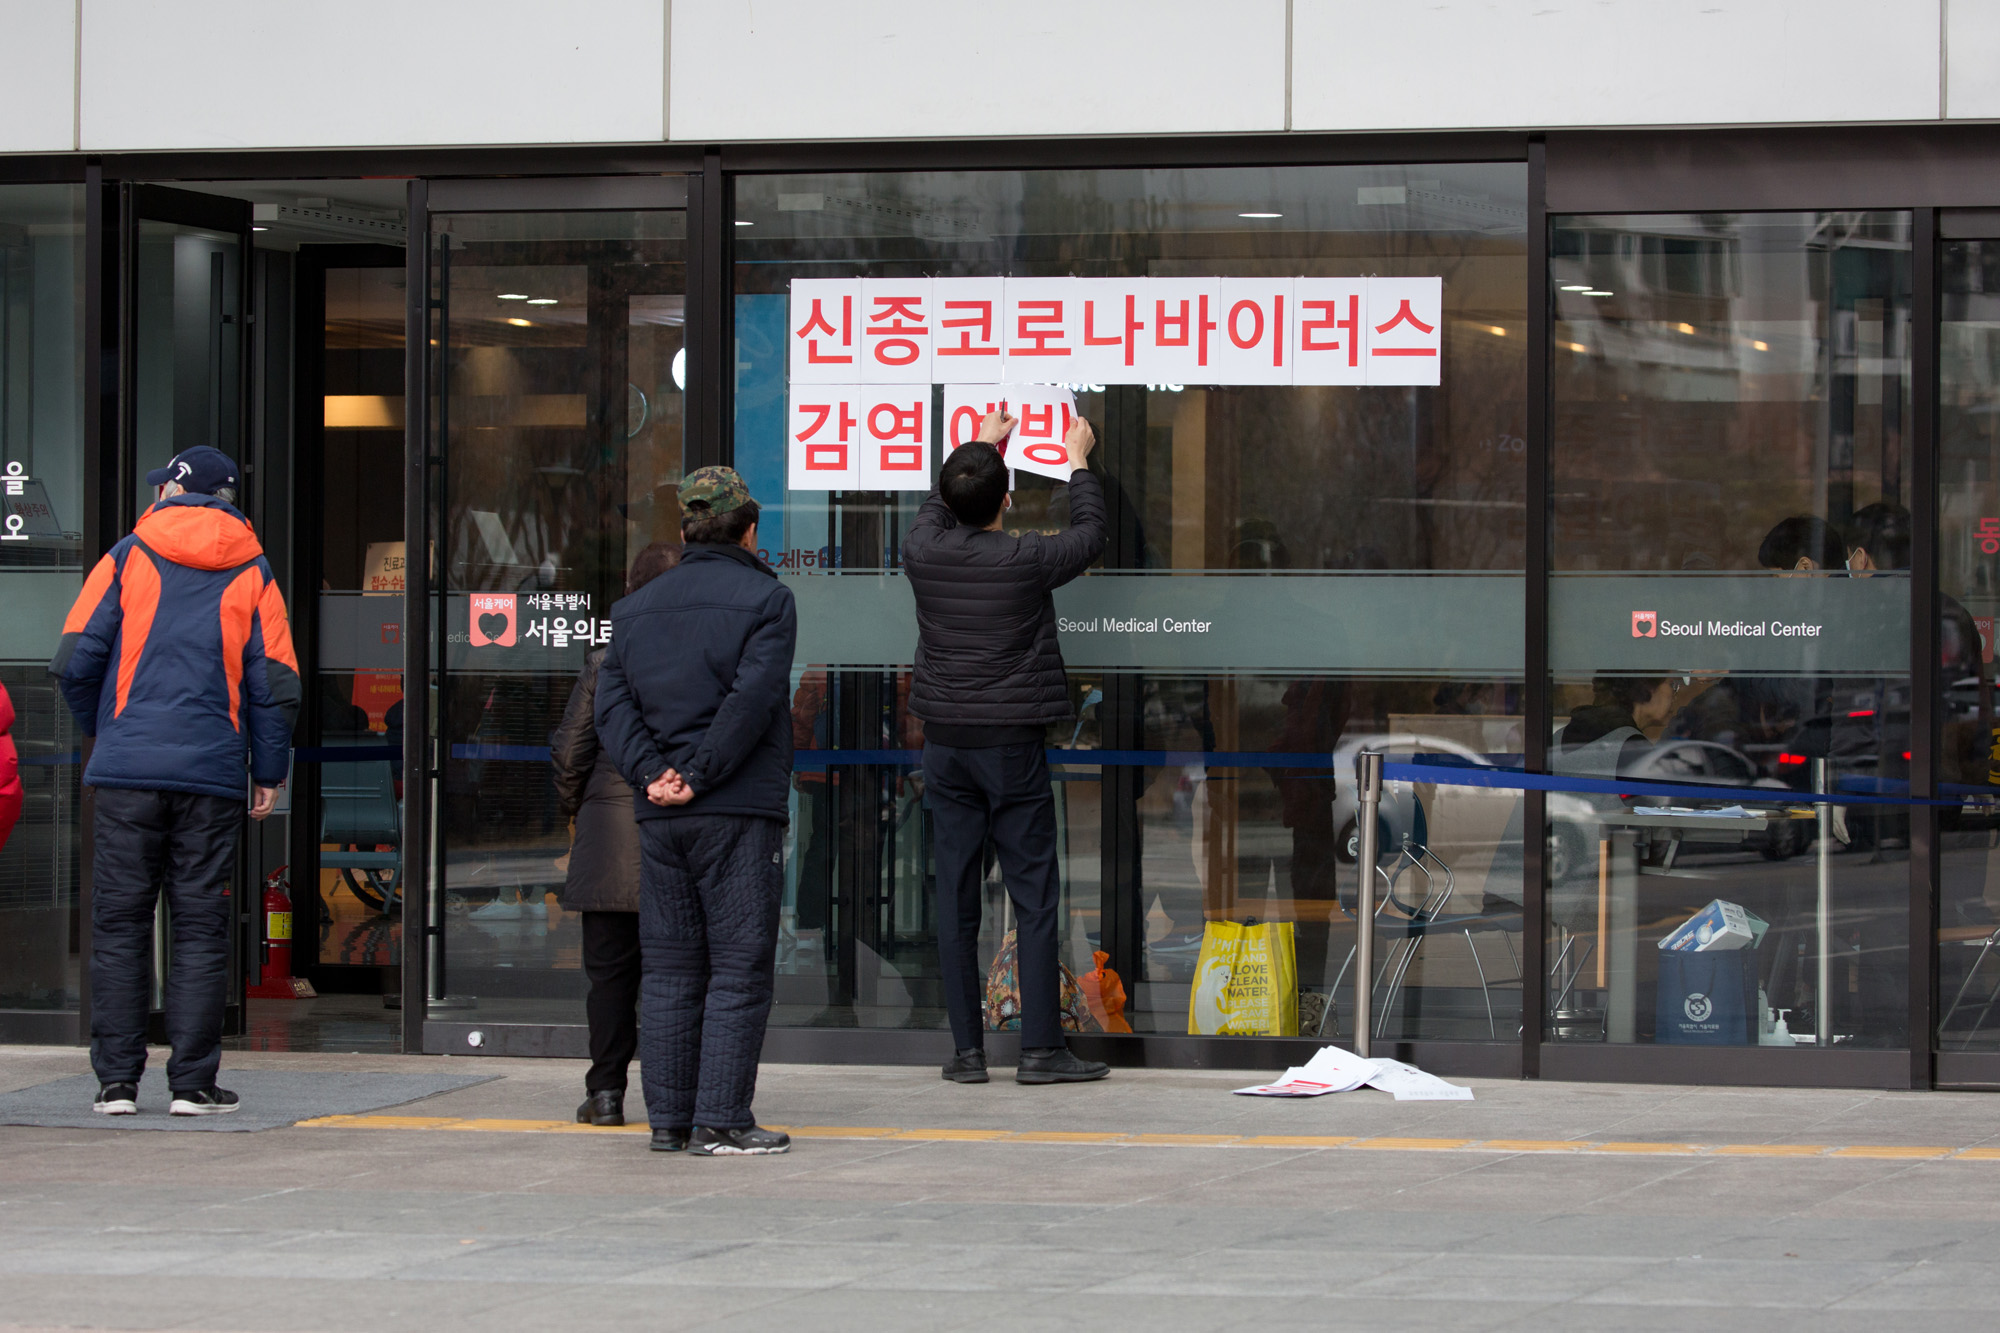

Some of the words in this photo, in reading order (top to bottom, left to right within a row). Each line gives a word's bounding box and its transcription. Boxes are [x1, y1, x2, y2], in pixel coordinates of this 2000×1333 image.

[797, 295, 1437, 366] 신종코로나바이러스
[795, 401, 923, 471] 감염
[0, 514, 29, 540] 오
[474, 597, 513, 610] 서울케어
[526, 593, 591, 611] 서울특별시
[1058, 617, 1098, 632] Seoul
[1103, 617, 1158, 632] Medical
[1162, 617, 1212, 633] Center
[1660, 620, 1703, 636] Seoul
[1707, 620, 1766, 637] Medical
[1770, 621, 1822, 637] Center
[1234, 964, 1268, 976] LOVE
[1230, 976, 1268, 987] CLEAN
[1228, 998, 1269, 1009] PLEASE
[1241, 1009, 1269, 1019] SAVE
